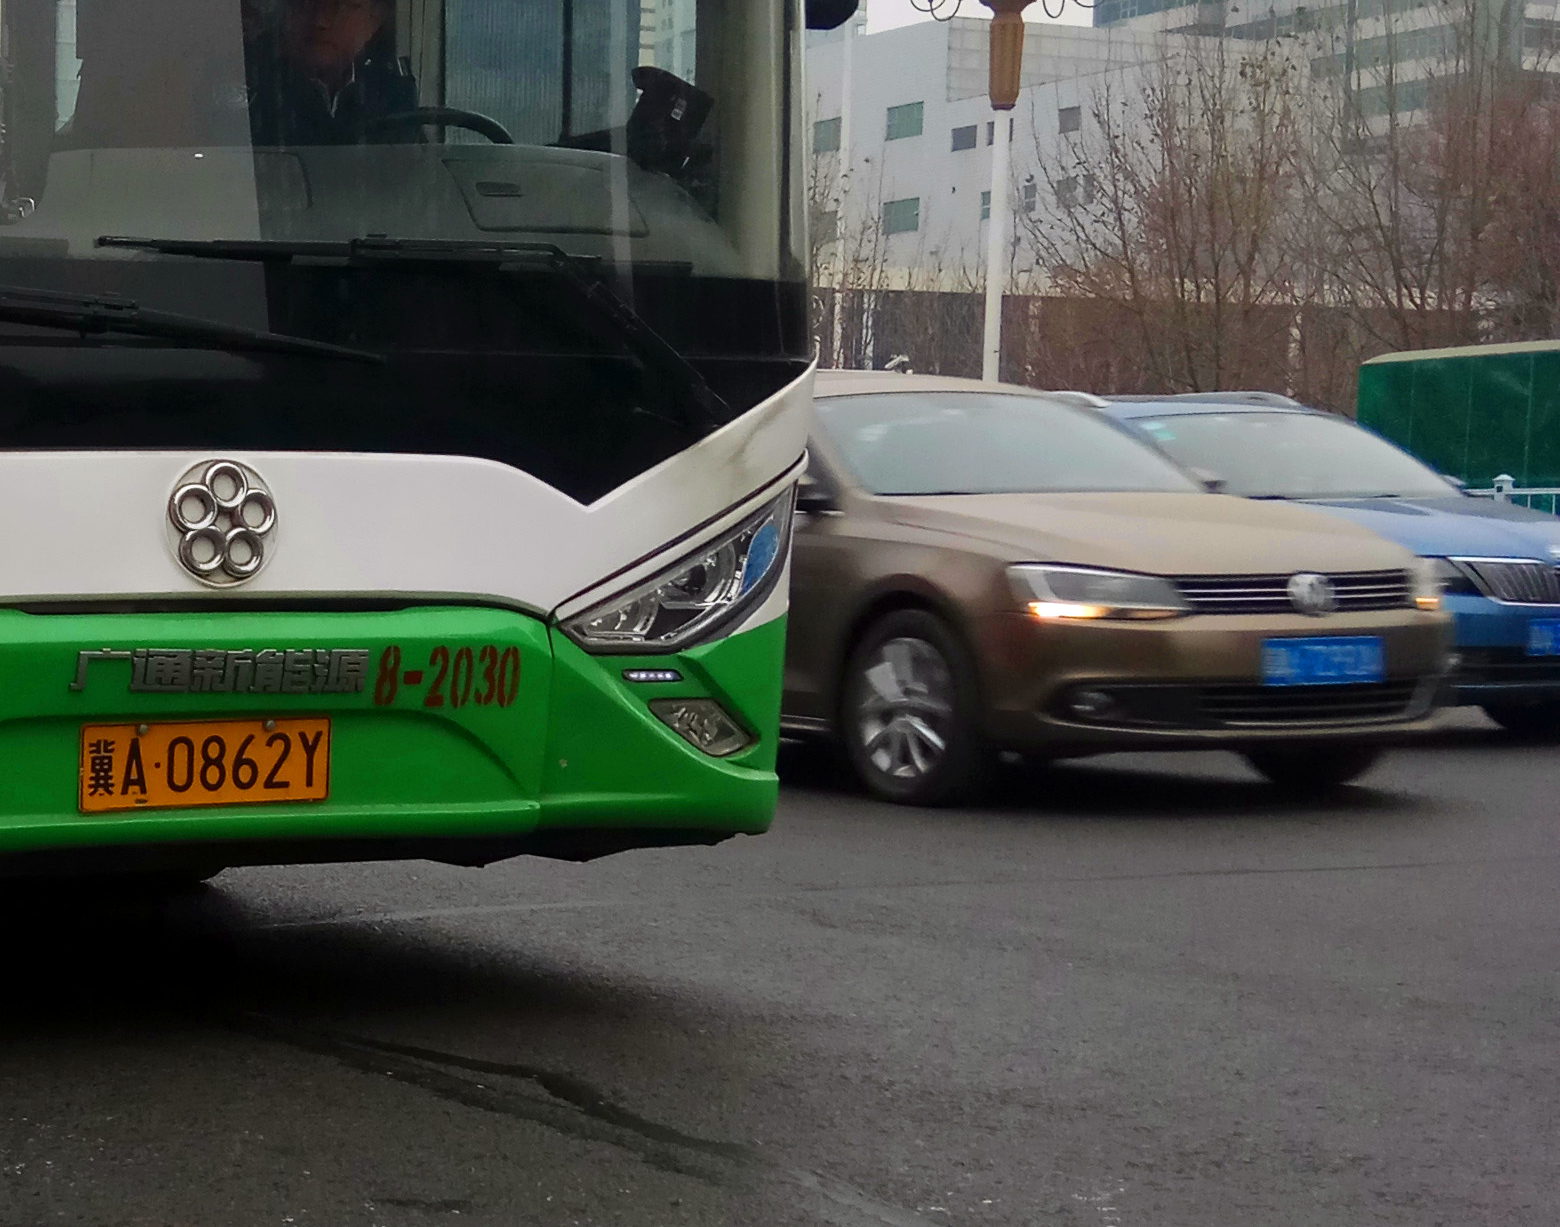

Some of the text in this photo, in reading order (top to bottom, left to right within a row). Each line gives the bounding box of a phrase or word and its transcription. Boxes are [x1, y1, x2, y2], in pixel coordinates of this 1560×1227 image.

[68, 647, 370, 693] 广通新能源
[373, 644, 522, 709] 8-2030
